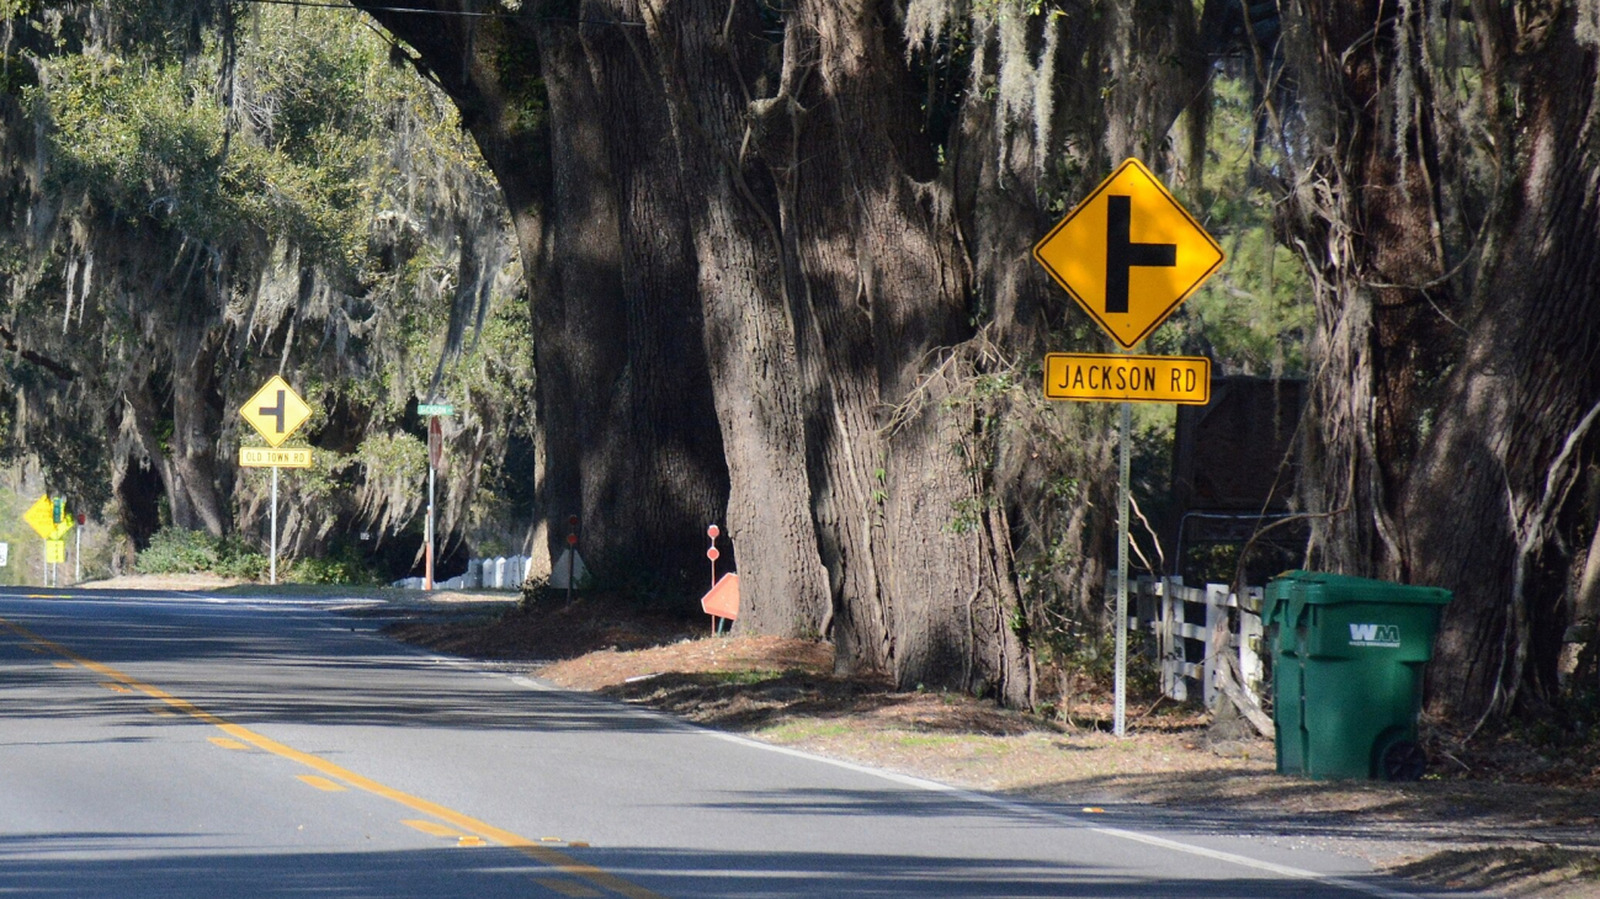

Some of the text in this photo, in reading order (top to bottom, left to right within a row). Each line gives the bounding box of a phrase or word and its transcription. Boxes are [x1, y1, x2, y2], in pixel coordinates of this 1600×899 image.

[1058, 365, 1196, 392] JACKSON RD
[246, 451, 305, 463] OLD TOWN RD
[1350, 624, 1401, 641] WM
